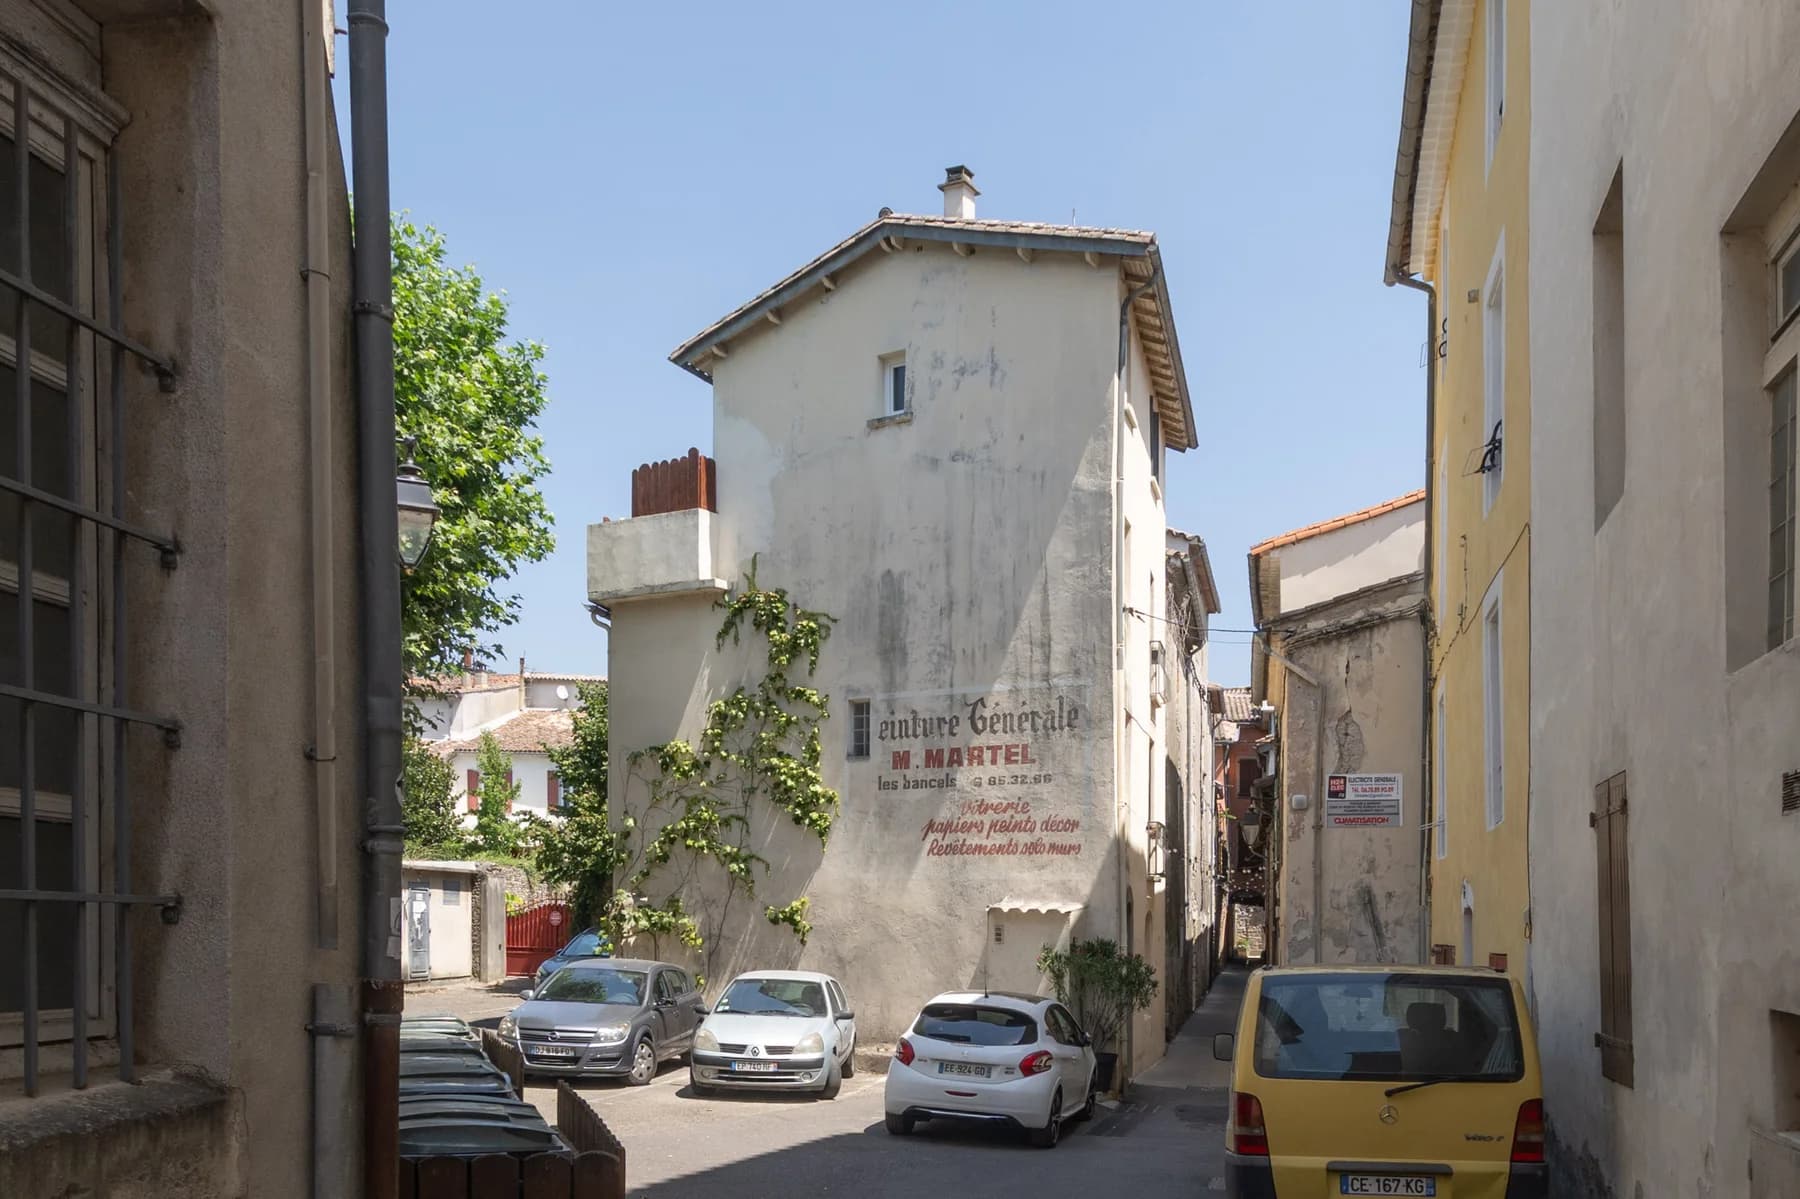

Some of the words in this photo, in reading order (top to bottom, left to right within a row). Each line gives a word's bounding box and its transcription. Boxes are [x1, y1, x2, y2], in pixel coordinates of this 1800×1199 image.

[924, 744, 1037, 770] MARTEL
[878, 775, 899, 792] les
[902, 773, 957, 791] bancels
[921, 817, 984, 842] papiers
[986, 814, 1038, 840] peints
[1040, 814, 1080, 834] décor
[927, 838, 1018, 857] Revêtements
